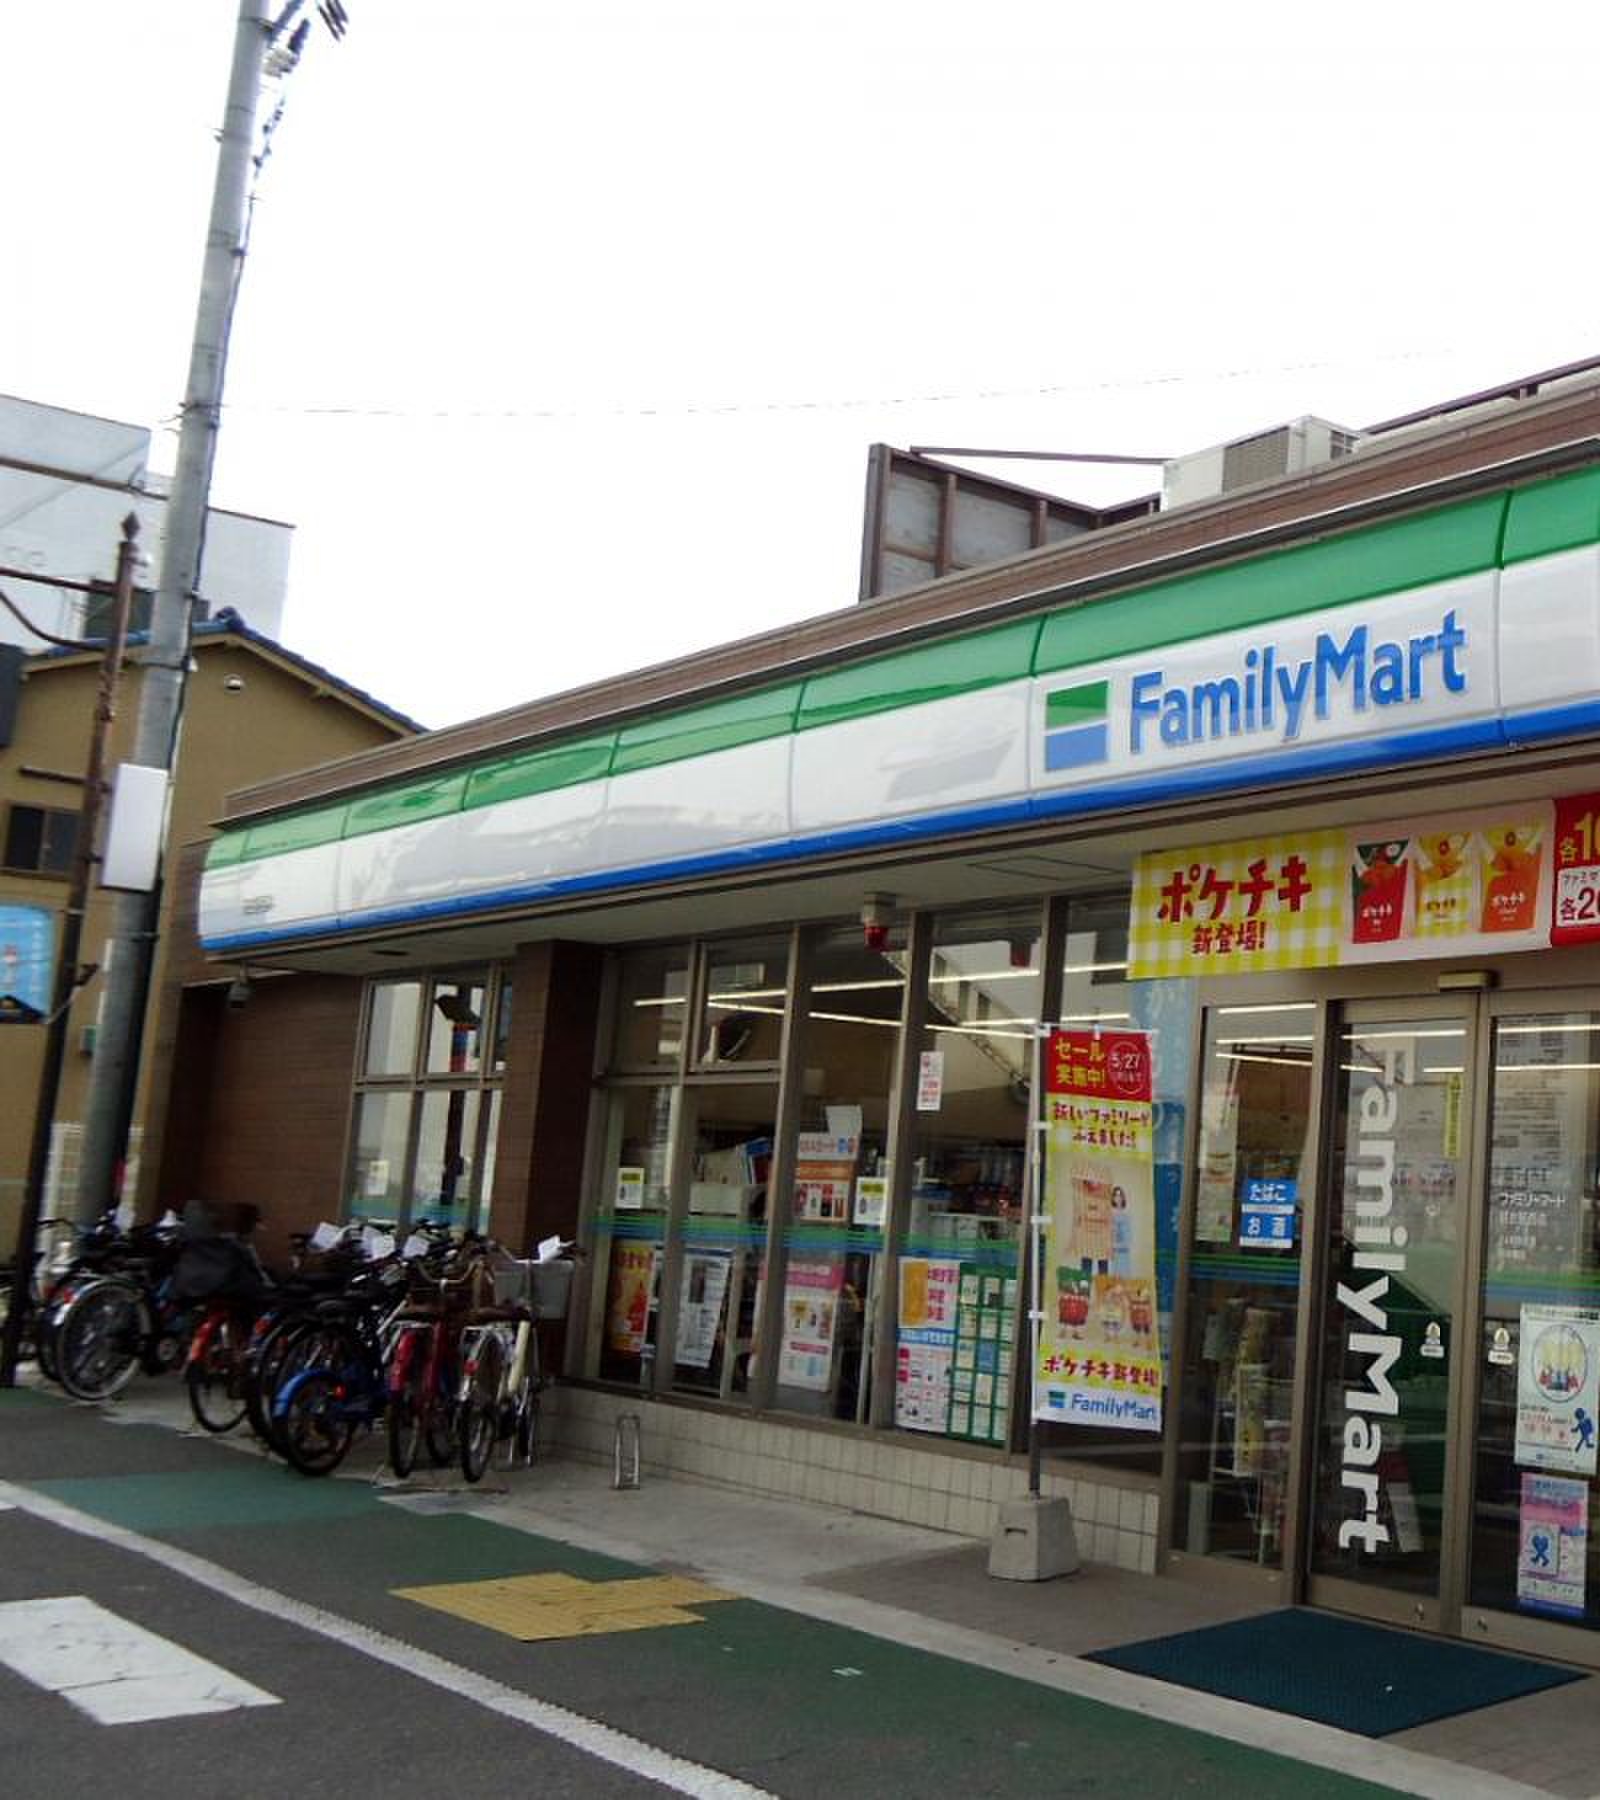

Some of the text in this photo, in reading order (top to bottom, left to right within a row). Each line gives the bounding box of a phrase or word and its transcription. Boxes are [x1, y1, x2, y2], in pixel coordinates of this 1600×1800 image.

[1130, 608, 1467, 754] FamilyMart
[1157, 855, 1313, 922] ポケチキ
[1191, 919, 1266, 954] 新登場!
[1055, 1037, 1105, 1061] セール
[1336, 1036, 1417, 1553] FamilyMart
